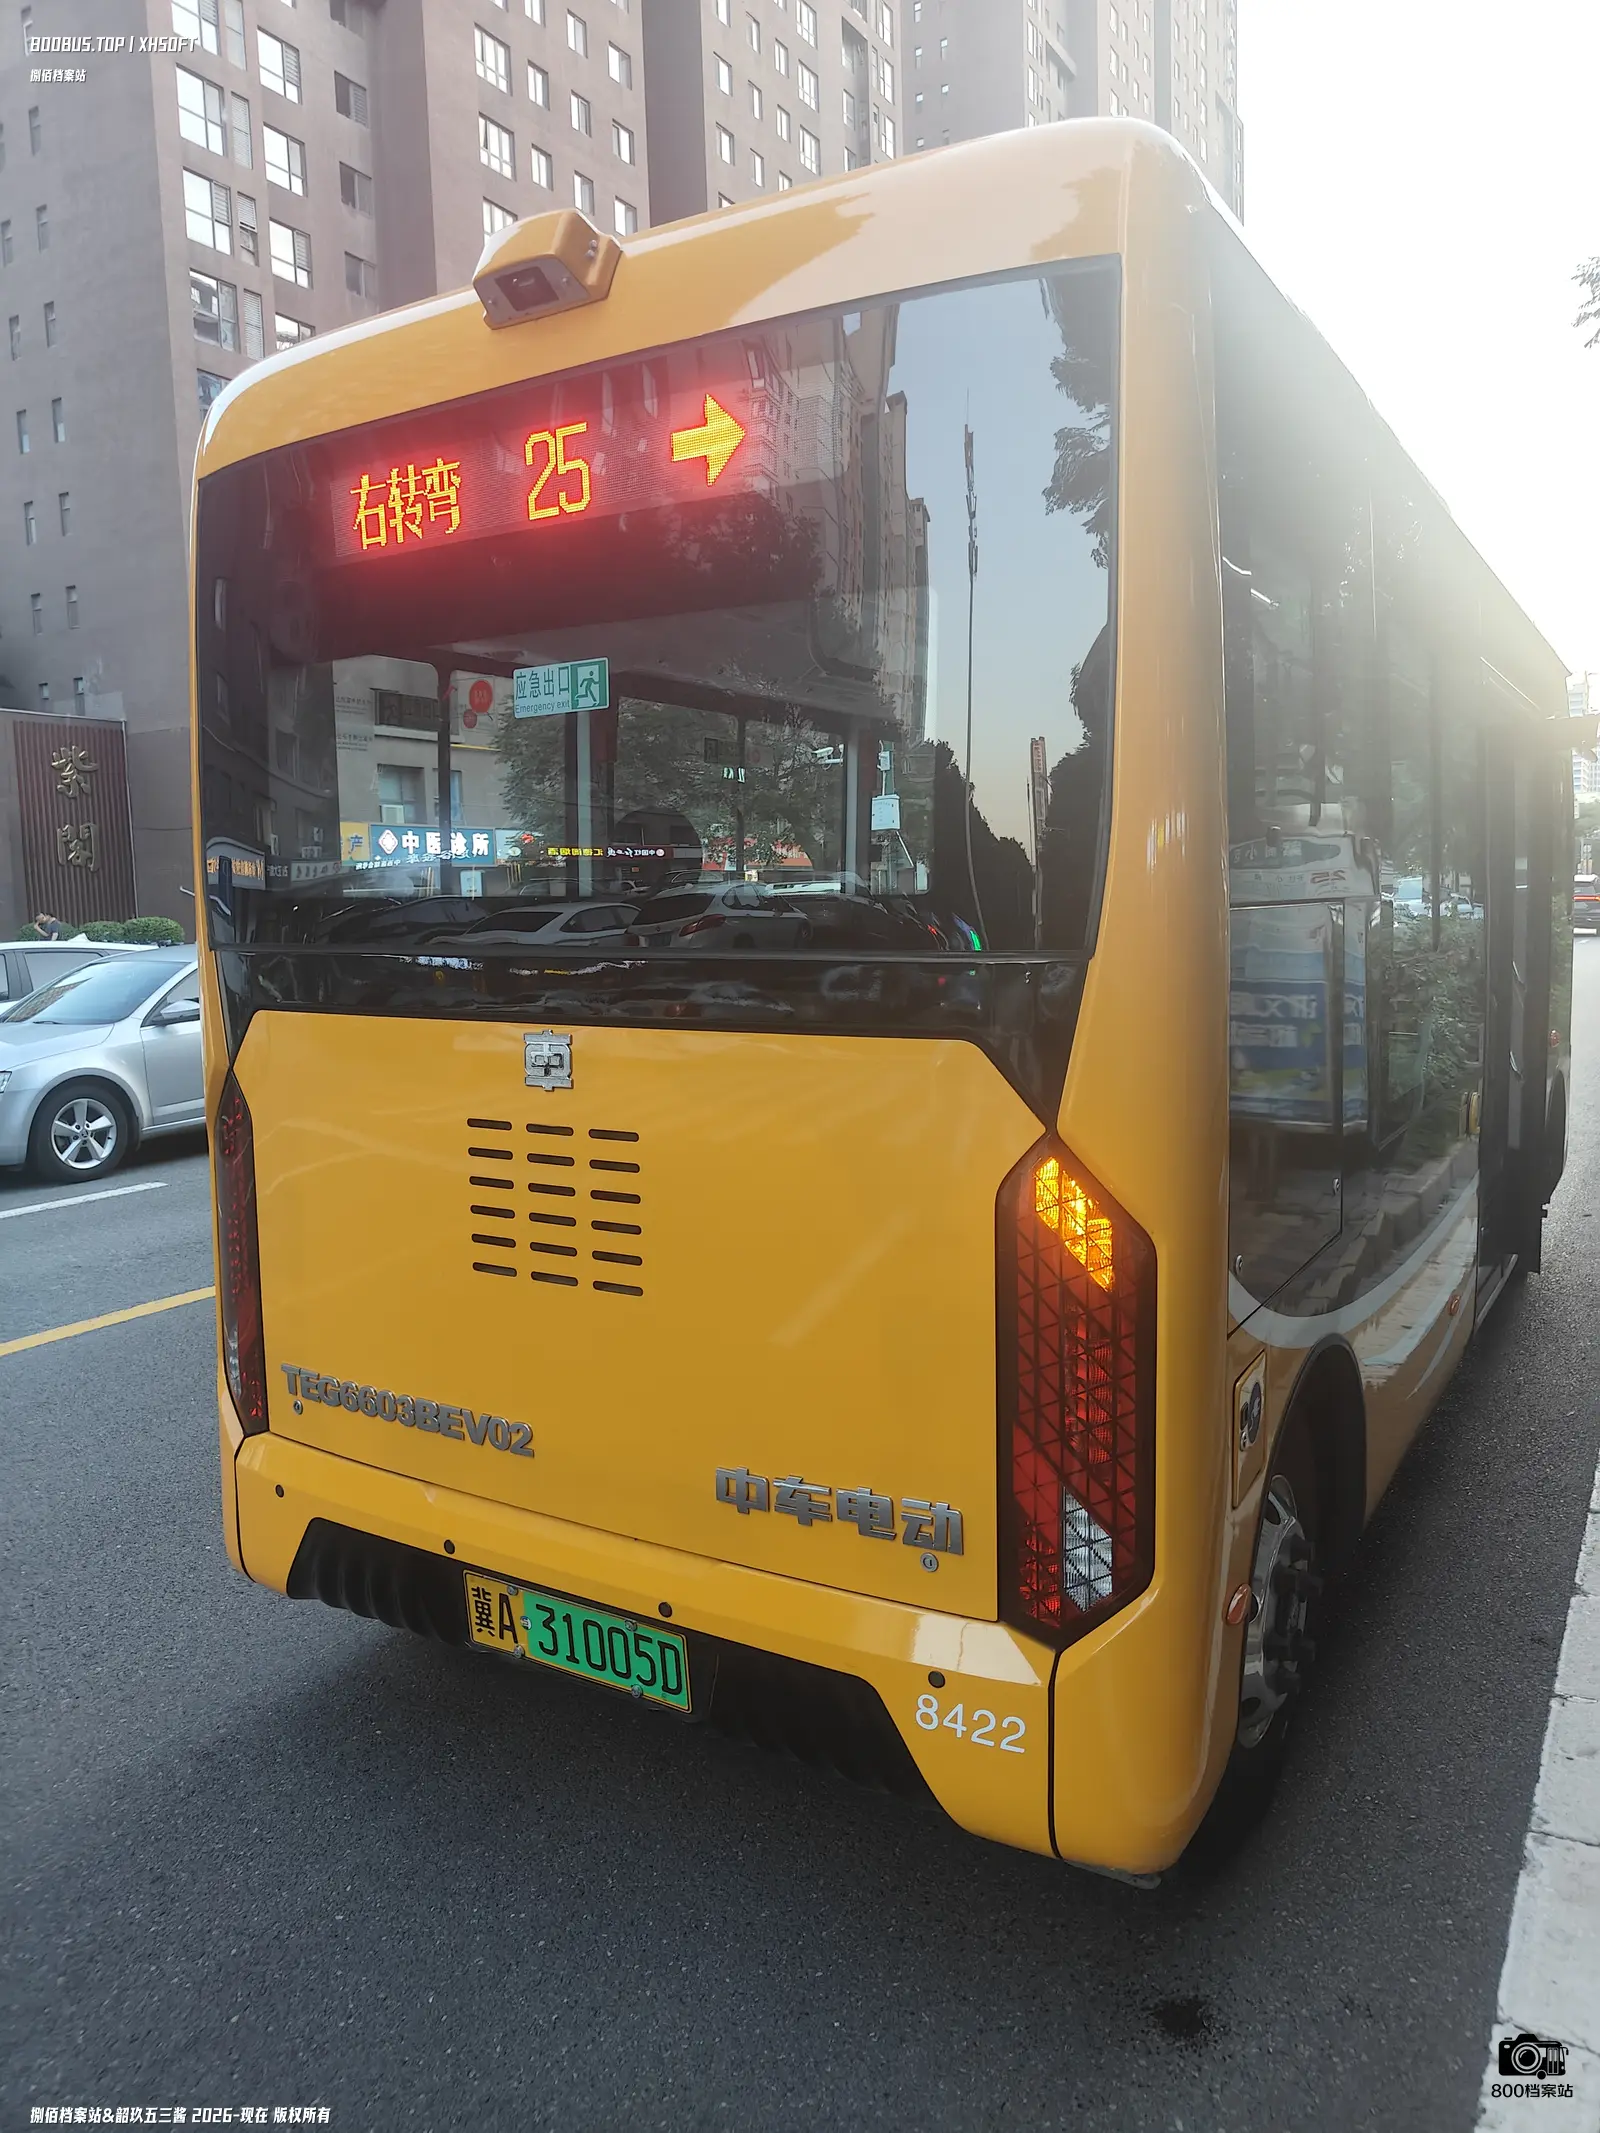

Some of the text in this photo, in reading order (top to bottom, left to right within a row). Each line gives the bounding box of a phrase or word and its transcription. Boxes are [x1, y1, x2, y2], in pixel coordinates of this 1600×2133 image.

[350, 421, 591, 550] 右转弯 25
[515, 700, 570, 714] Emergency exit
[516, 666, 570, 700] 应急出口
[402, 830, 490, 856] 中医诊所
[281, 1363, 534, 1458] TEG6603BEV02
[715, 1466, 964, 1555] 中车电动
[915, 1694, 1025, 1754] 8422
